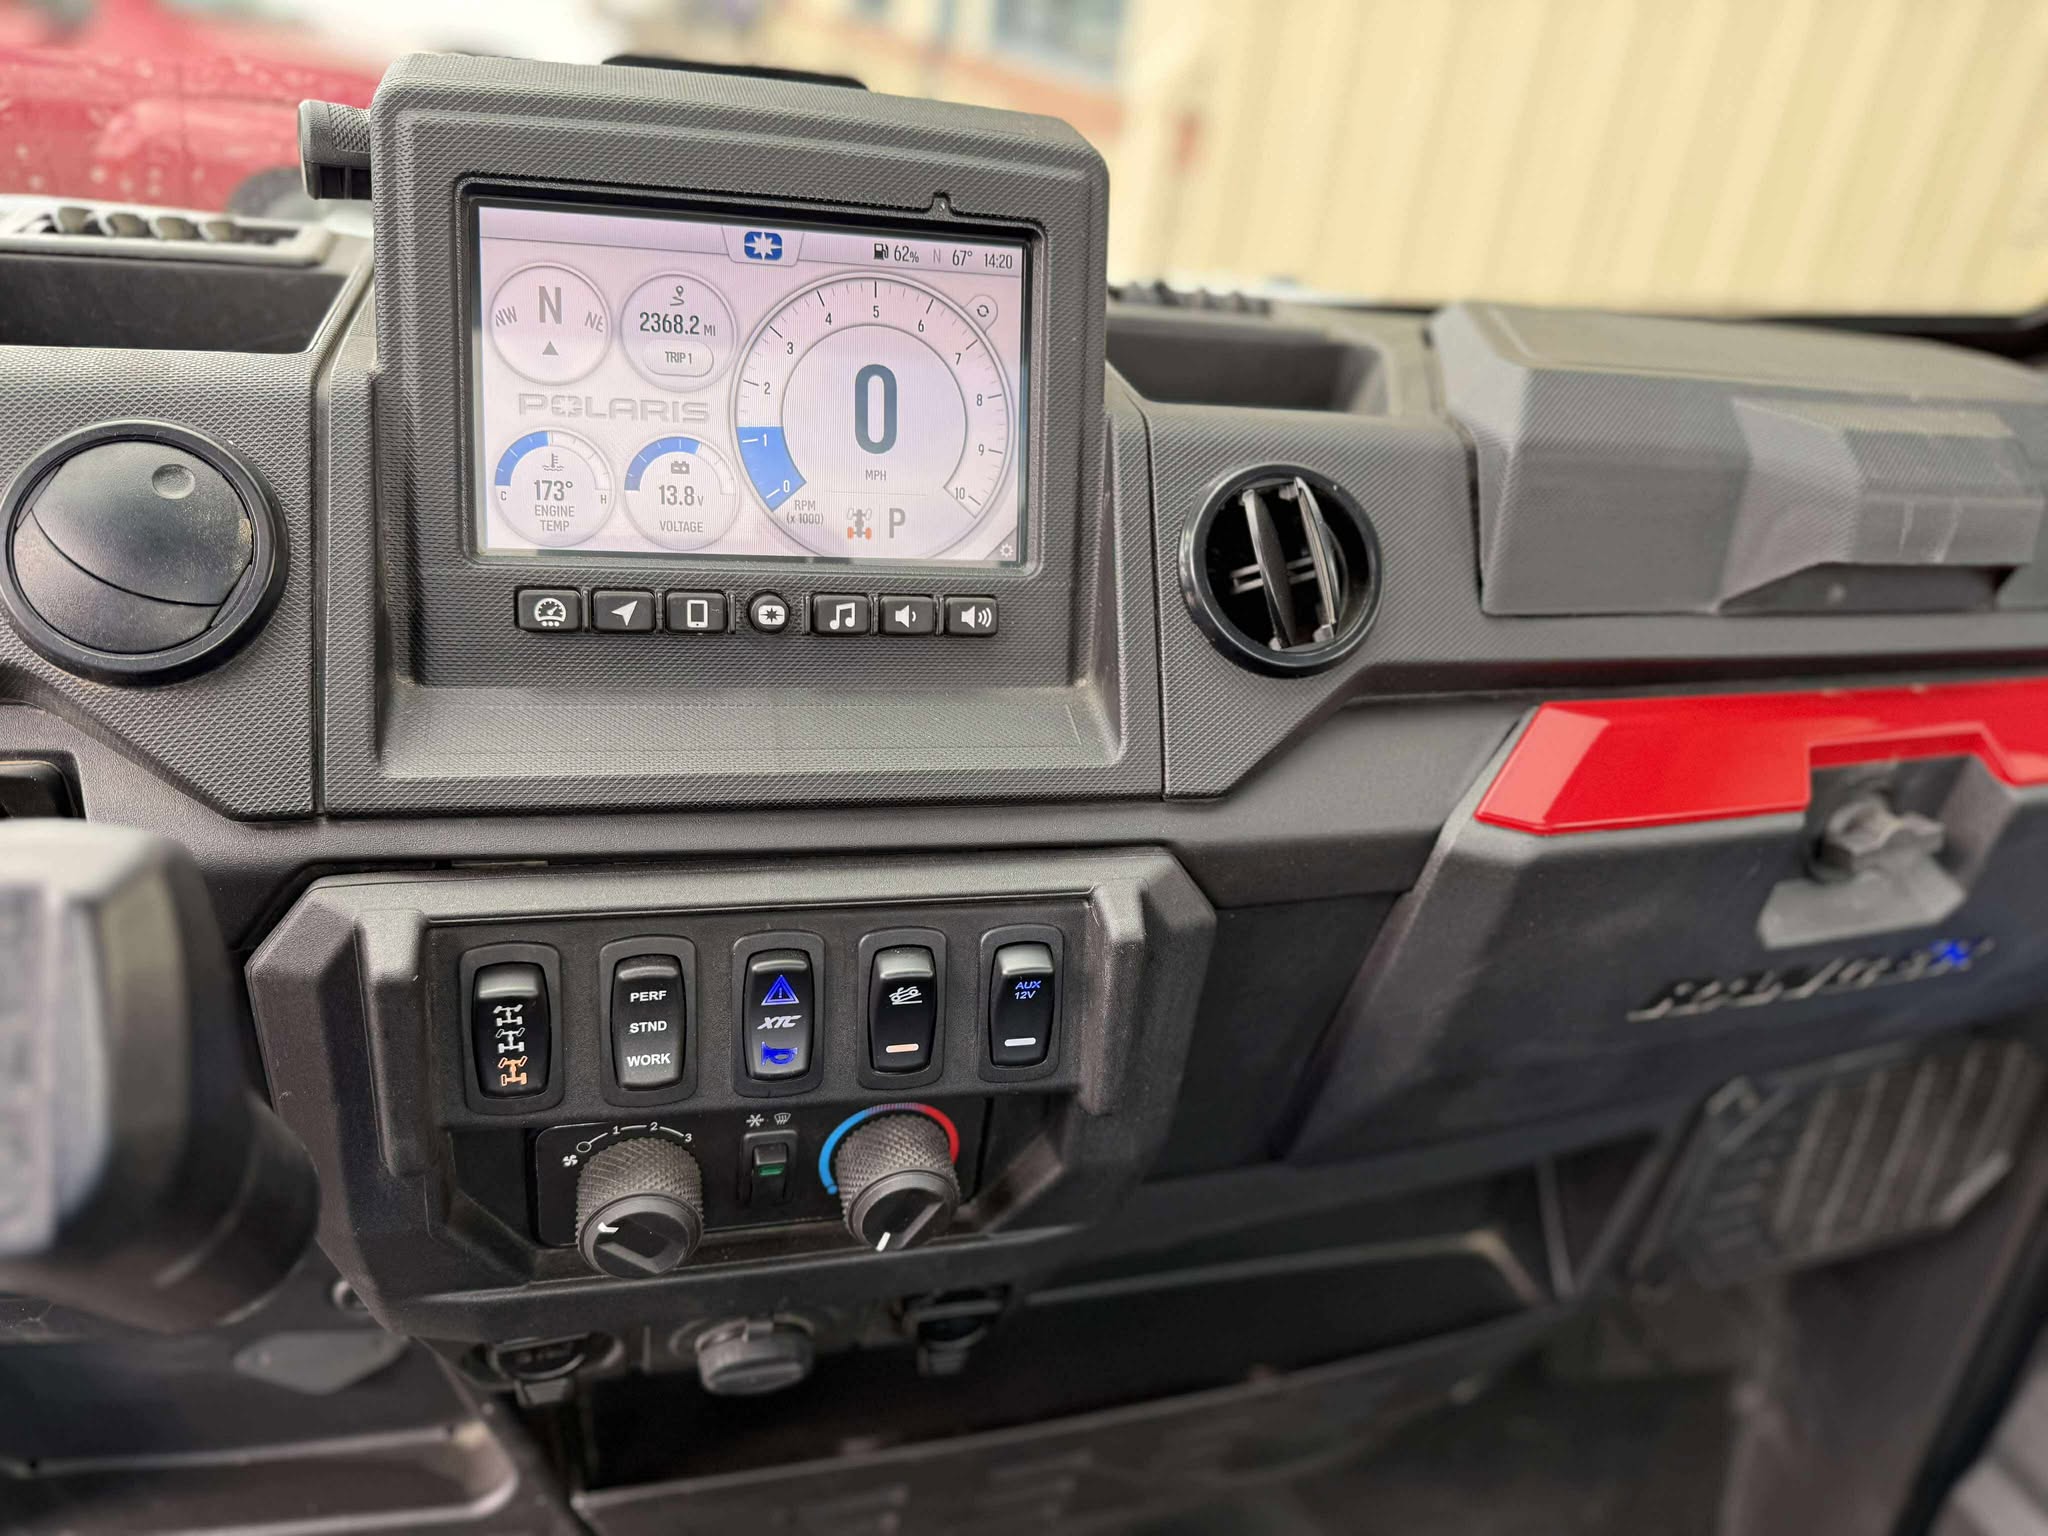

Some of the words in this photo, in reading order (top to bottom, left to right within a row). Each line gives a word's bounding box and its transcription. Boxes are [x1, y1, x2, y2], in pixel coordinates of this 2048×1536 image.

[894, 245, 920, 262] 62%
[952, 250, 972, 266] 67°
[984, 252, 1012, 269] 14:20
[538, 285, 562, 325] N
[872, 306, 880, 318] 5
[639, 312, 700, 335] 2368.2
[704, 324, 716, 336] MI
[825, 313, 832, 326] 4
[918, 320, 924, 332] 6
[786, 342, 794, 354] 3
[665, 351, 686, 364] TRIP
[688, 352, 692, 364] 1
[954, 352, 962, 366] 7
[764, 382, 771, 395] 2
[976, 394, 983, 406] 8
[518, 392, 709, 423] POLARIS
[854, 364, 898, 454] 0
[762, 434, 768, 446] 1
[978, 444, 984, 456] 9
[865, 470, 887, 481] MPH
[534, 480, 573, 501] 173°
[783, 480, 790, 492] 0
[500, 491, 507, 501] C
[600, 494, 607, 505] H
[658, 484, 695, 506] 13.8
[955, 488, 965, 500] 10
[534, 505, 575, 518] ENGINE
[794, 500, 816, 511] RPM
[540, 520, 570, 532] TEMP
[659, 520, 703, 533] VOLTAGE
[888, 508, 906, 538] P
[1015, 980, 1042, 990] AUX
[629, 990, 668, 1003] PERF
[1014, 990, 1036, 1000] 12V
[629, 1020, 668, 1033] STND
[757, 1015, 802, 1029] XTC
[626, 1052, 671, 1067] WORK
[611, 1125, 620, 1135] 1
[649, 1121, 659, 1132] 2
[683, 1133, 693, 1143] 3
